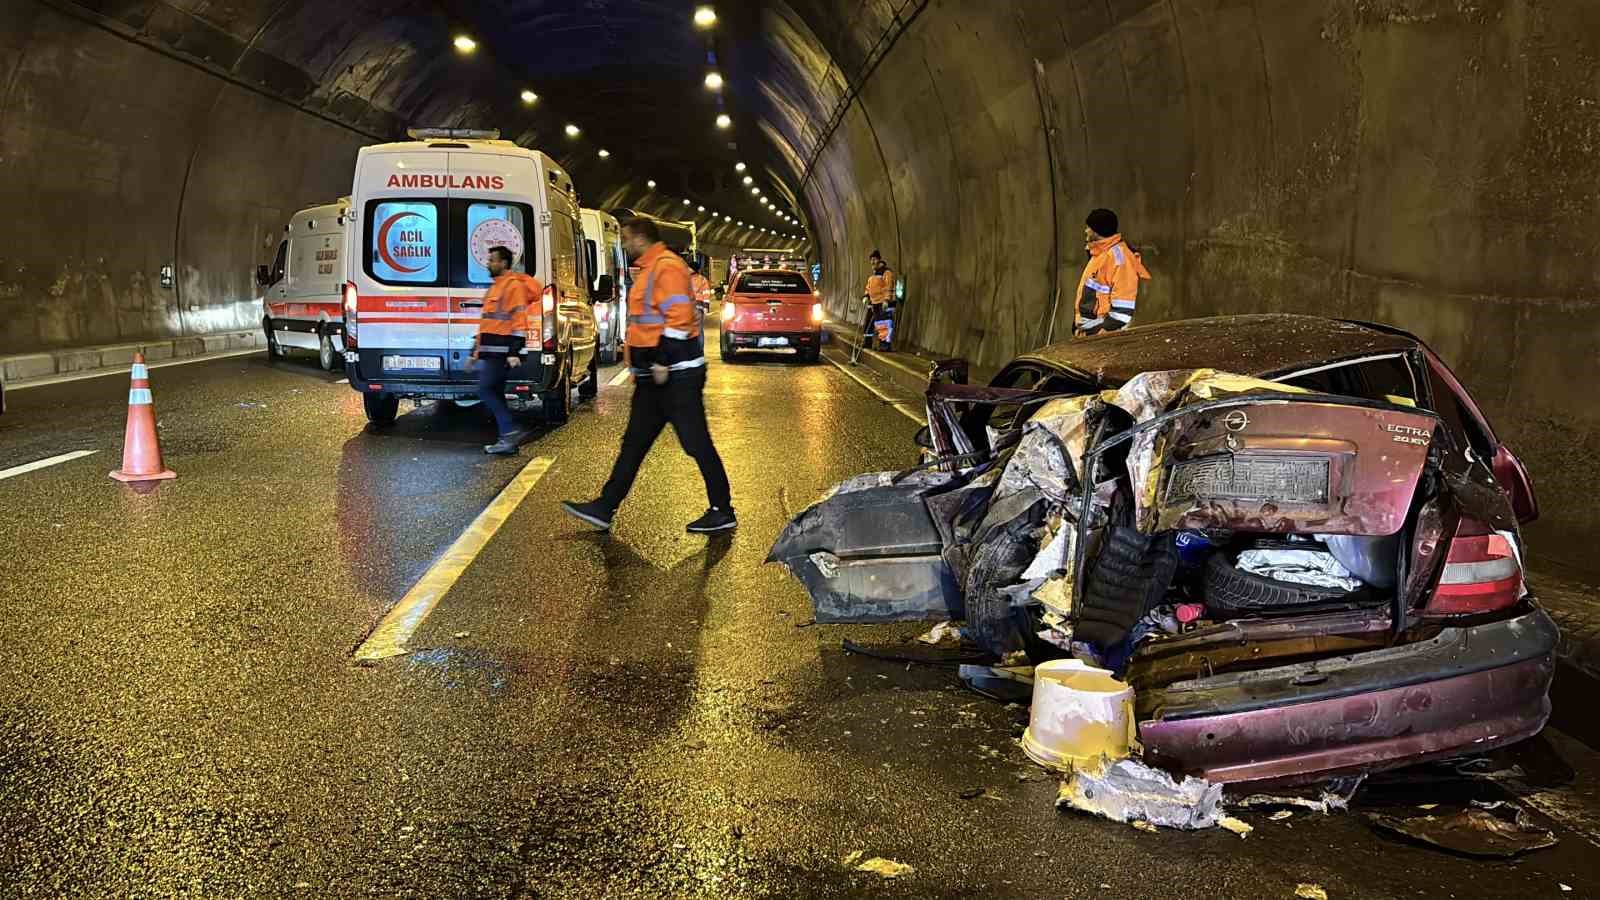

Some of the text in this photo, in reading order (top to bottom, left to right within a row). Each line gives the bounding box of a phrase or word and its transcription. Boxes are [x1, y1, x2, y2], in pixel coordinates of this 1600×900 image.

[387, 174, 505, 189] AMBULANS
[400, 229, 424, 242] ACİL
[393, 244, 431, 257] SAĞLIK
